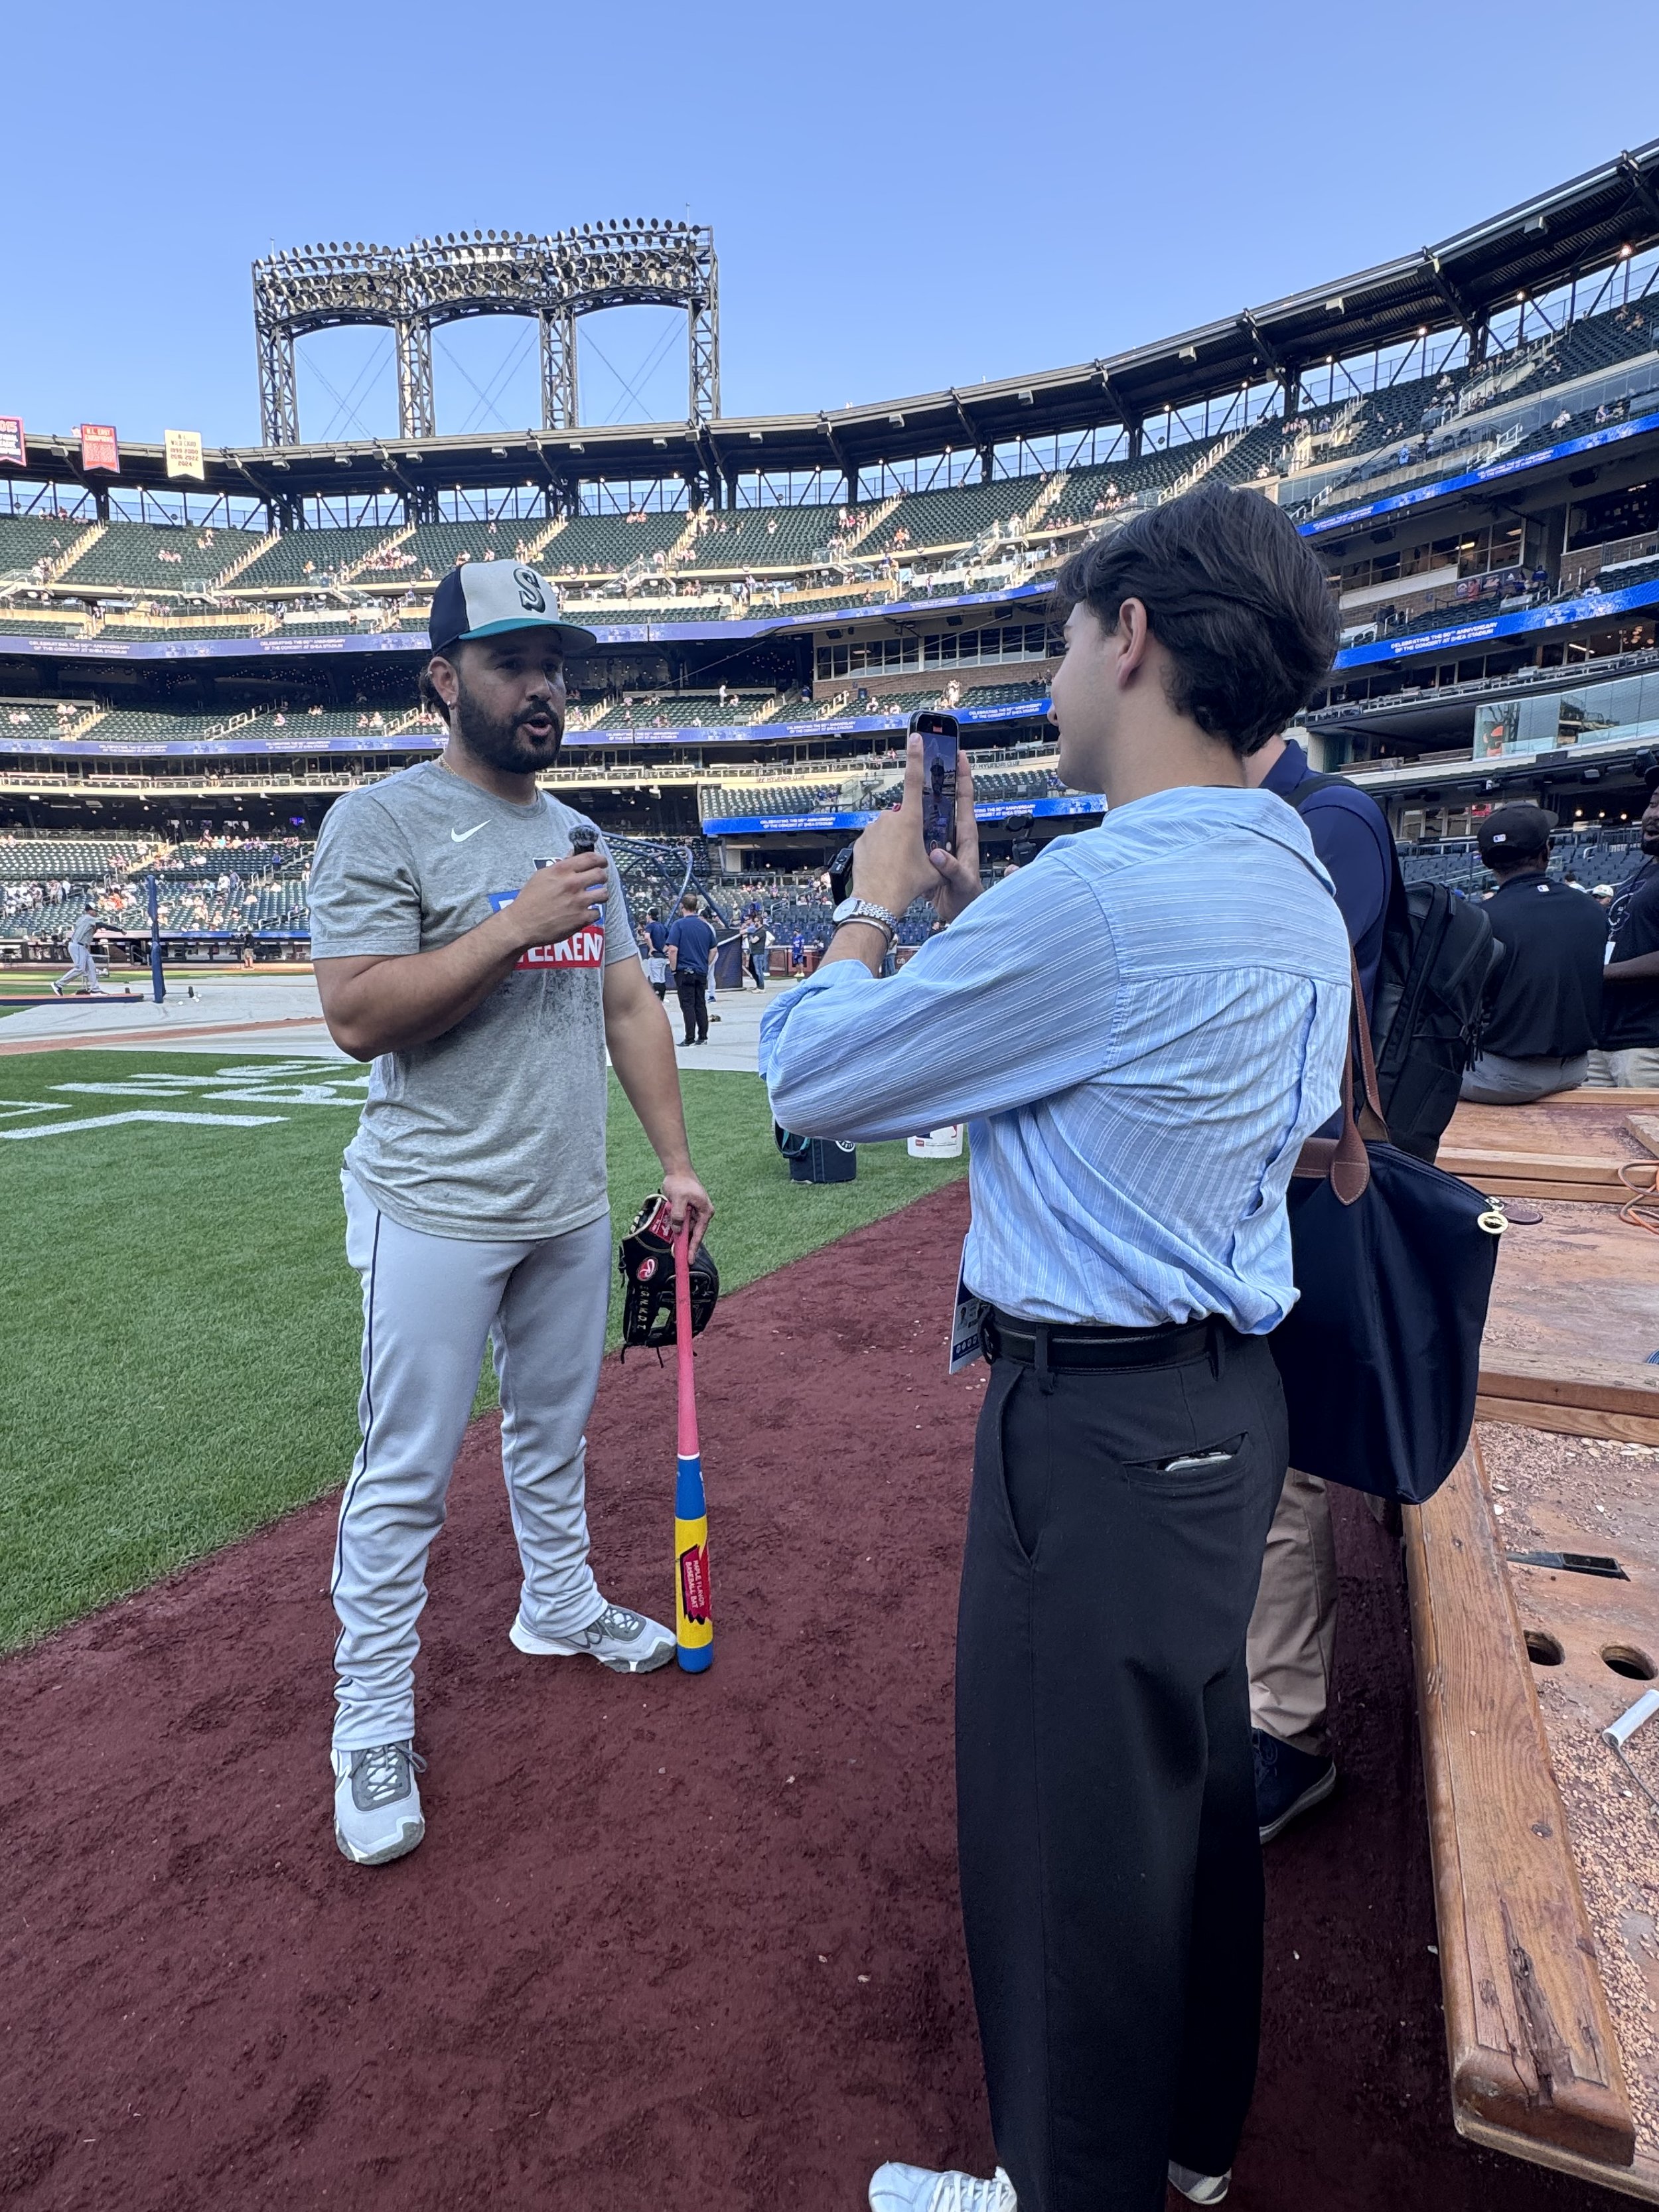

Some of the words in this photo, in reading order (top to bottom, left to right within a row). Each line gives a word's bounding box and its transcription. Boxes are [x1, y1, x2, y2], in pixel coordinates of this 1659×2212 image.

[0, 420, 18, 433] 015
[513, 567, 545, 613] S
[518, 932, 603, 962] EEKEN
[685, 1561, 695, 1595] BASEBALL
[690, 1595, 699, 1609] BAT
[696, 1582, 705, 1607] FLAVOR
